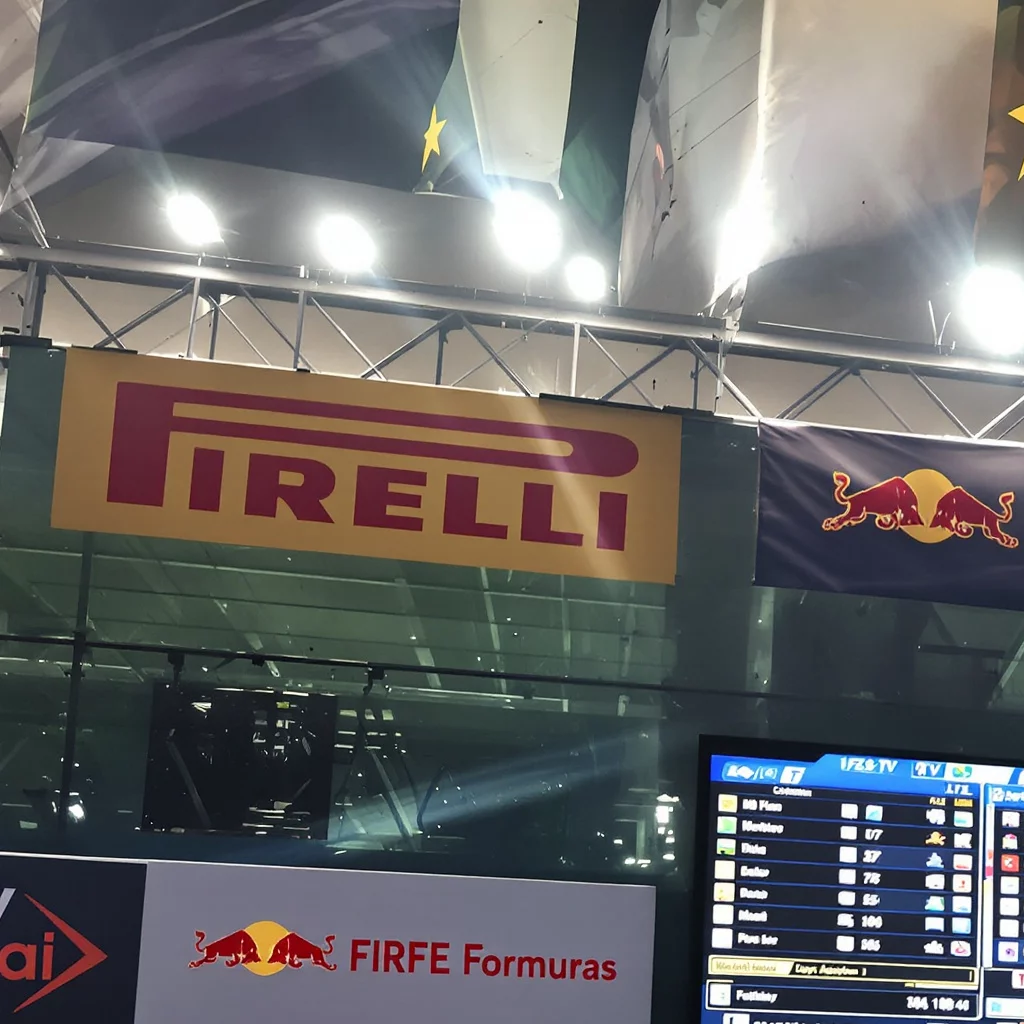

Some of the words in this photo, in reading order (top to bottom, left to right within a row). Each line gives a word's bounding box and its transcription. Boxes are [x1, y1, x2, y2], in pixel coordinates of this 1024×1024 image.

[106, 381, 639, 552] PIRELLI
[350, 939, 450, 975] FIRFE
[463, 943, 617, 981] Formuras
